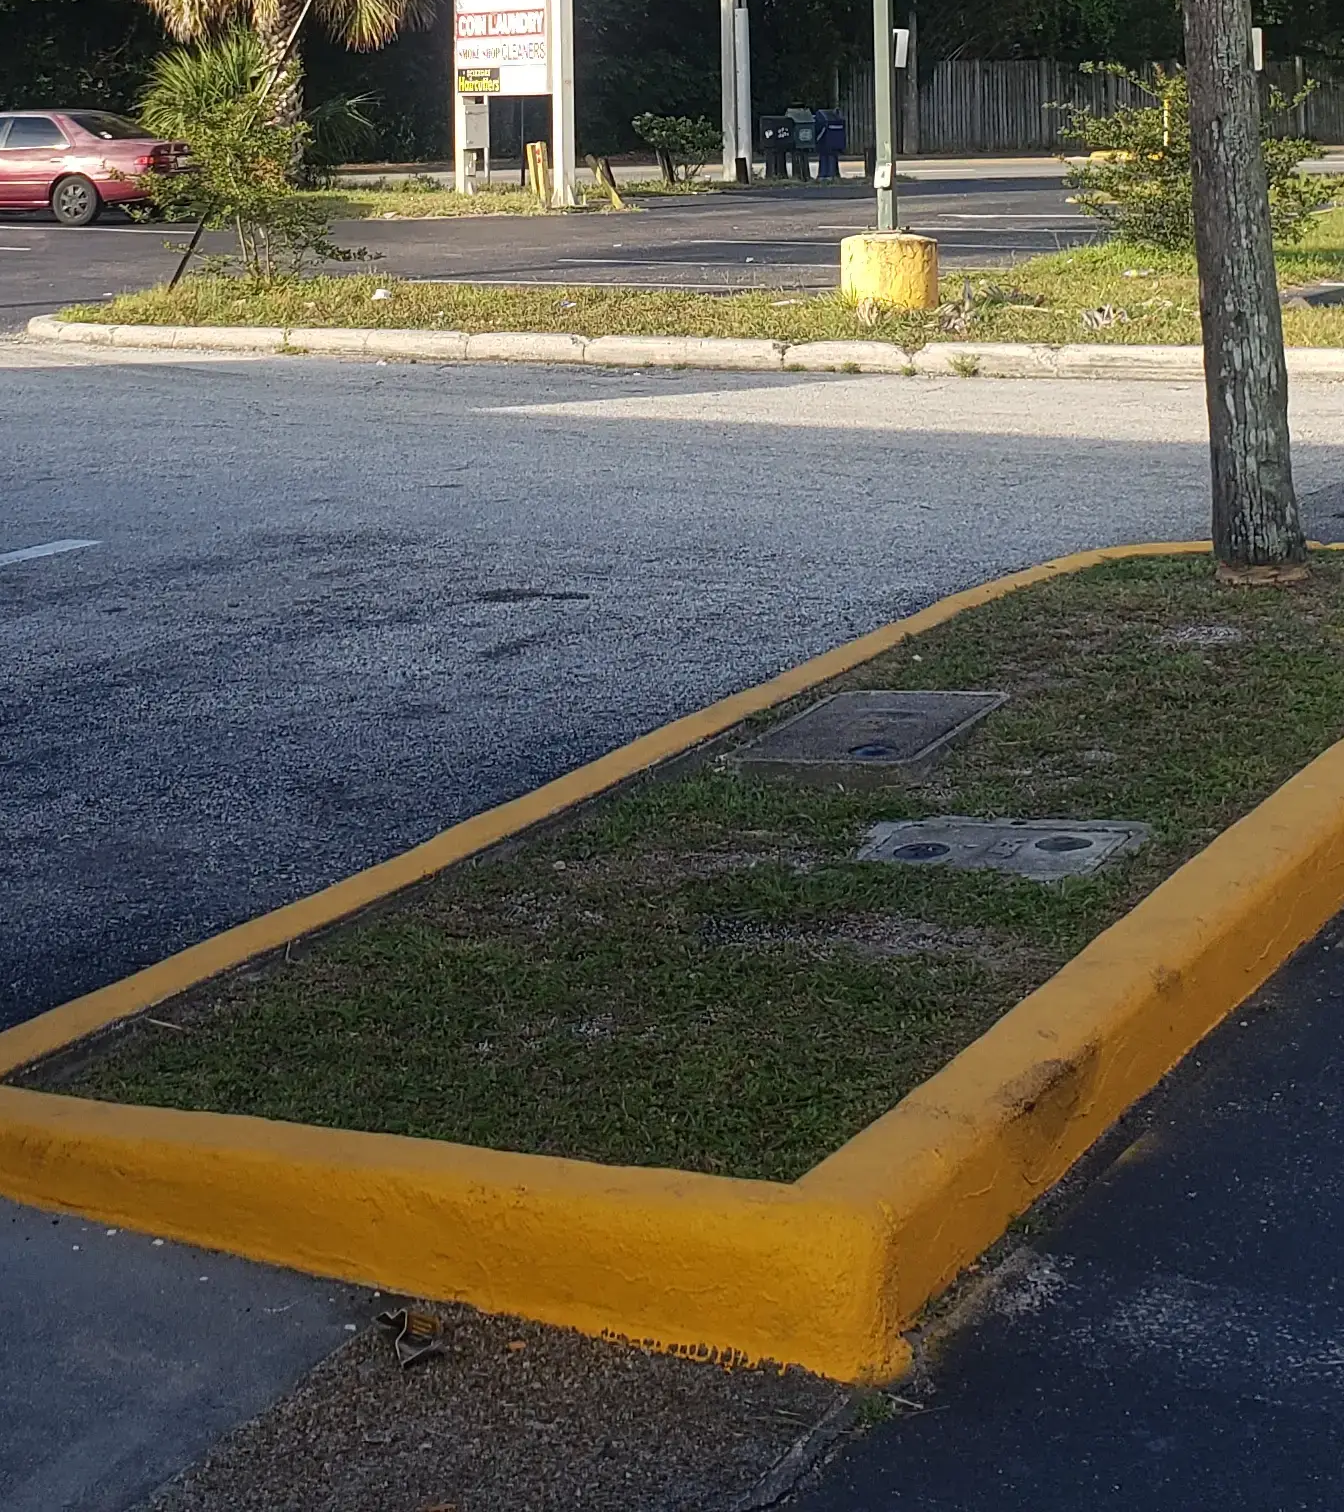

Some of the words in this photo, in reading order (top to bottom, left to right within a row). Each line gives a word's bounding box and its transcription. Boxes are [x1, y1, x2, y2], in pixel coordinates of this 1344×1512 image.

[458, 14, 487, 37] COIN
[488, 10, 544, 36] LAUNDRY
[501, 41, 546, 61] CLEANERS
